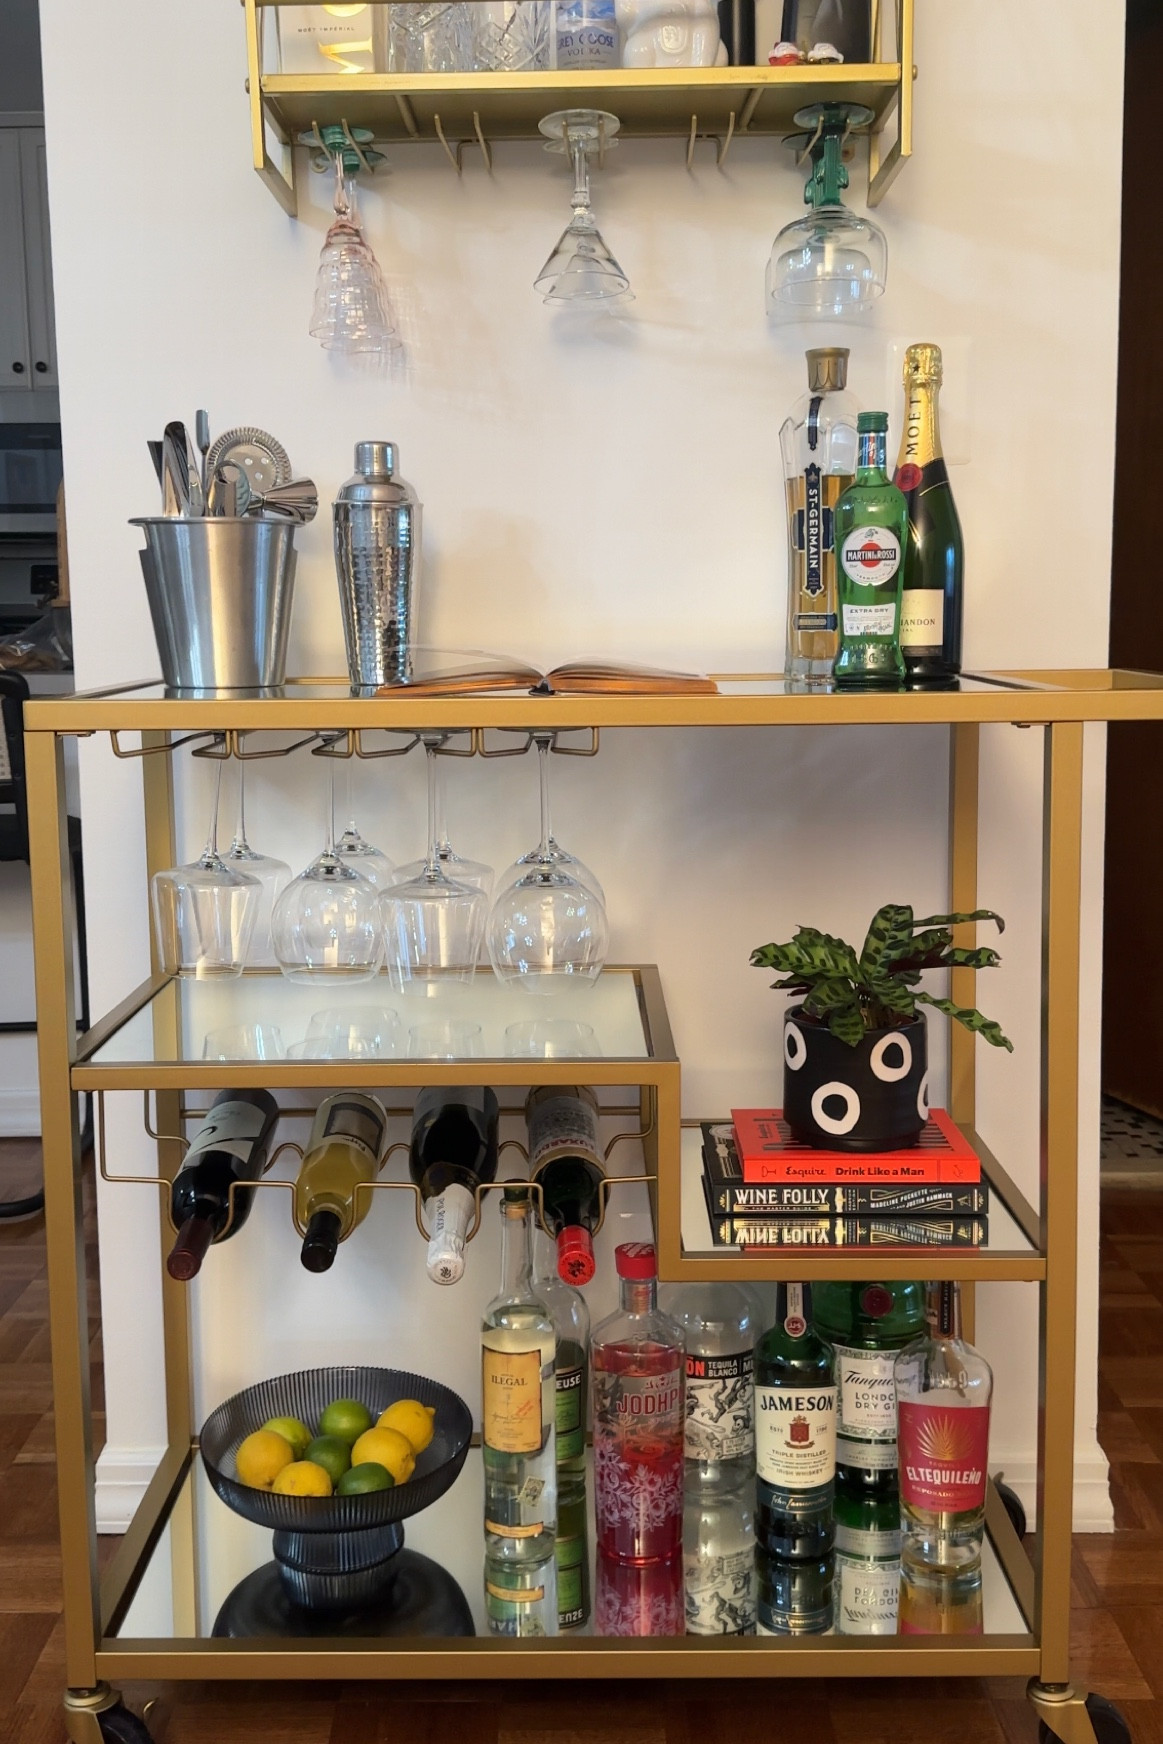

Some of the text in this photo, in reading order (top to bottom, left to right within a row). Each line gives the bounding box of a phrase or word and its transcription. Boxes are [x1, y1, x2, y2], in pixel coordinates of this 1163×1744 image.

[808, 488, 819, 569] ST-GERMAIN
[847, 551, 874, 561] MARTINI
[877, 550, 895, 560] ROSSI
[786, 1166, 925, 1178] Esquire Drink Like a Man
[734, 1188, 779, 1205] WINE
[782, 1188, 830, 1205] FOLLY
[870, 1197, 899, 1209] MADELINE
[900, 1188, 928, 1203] PUCKETTE
[905, 1197, 926, 1209] JUSTIN
[926, 1192, 953, 1202] HAMMACK
[708, 1359, 737, 1370] TEQUILA
[708, 1367, 738, 1378] BLANCO
[491, 1374, 527, 1387] ILEGAL
[556, 1374, 581, 1389] EUSE
[760, 1395, 835, 1412] JAMESON
[855, 1401, 878, 1409] DRY
[772, 1449, 827, 1459] TRIPLE DISTILLED
[795, 1468, 823, 1477] WHISKEY
[906, 1466, 919, 1481] EL
